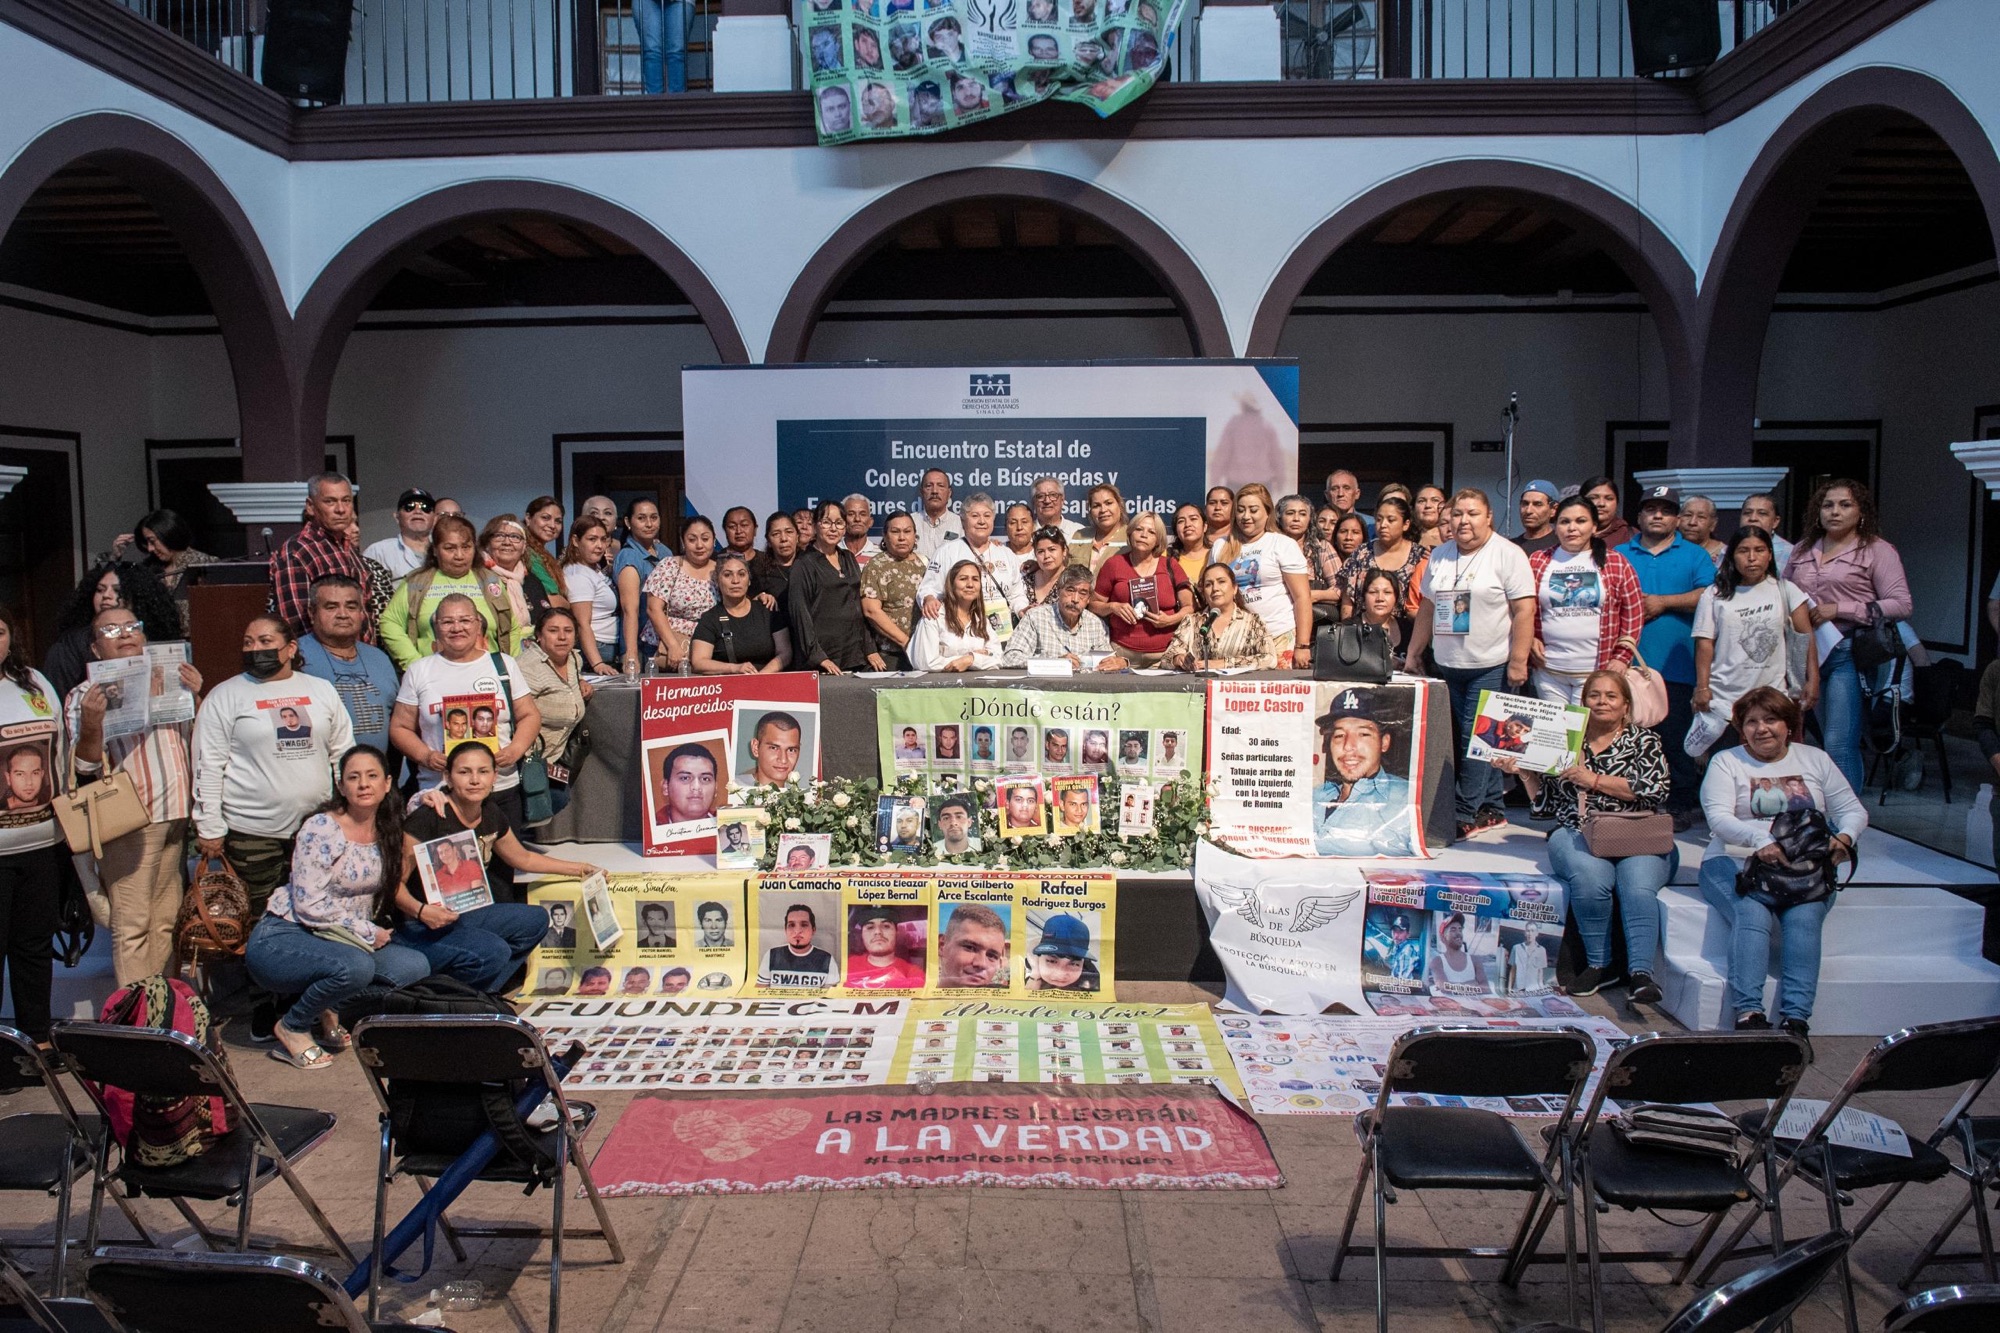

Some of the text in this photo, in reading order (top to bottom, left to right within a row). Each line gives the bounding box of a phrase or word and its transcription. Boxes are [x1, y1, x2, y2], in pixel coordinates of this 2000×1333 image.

[891, 439, 1092, 459] Encuentro Estatal de
[865, 468, 964, 487] Colectos
[968, 468, 992, 487] de
[1108, 471, 1119, 486] y
[1740, 608, 1756, 618] VEN
[1763, 603, 1774, 612] MI
[655, 683, 723, 702] Hermanos
[1219, 681, 1311, 696] Johan Edgardo
[1225, 698, 1304, 713] Lopez Castro
[1495, 694, 1527, 704] Colectivo
[1538, 701, 1562, 710] Padres
[643, 699, 735, 722] desaparecidos
[959, 696, 1121, 722] ¿Dónde están?
[1502, 702, 1527, 711] Madres
[1539, 707, 1557, 716] Hijos
[1503, 708, 1554, 722] Desaparecidos
[13, 728, 25, 736] soy
[1221, 726, 1241, 735] Edad:
[280, 739, 309, 747] SWAGGY
[1248, 737, 1279, 747] 30 años
[1221, 752, 1294, 763] Señas particulares:
[1230, 767, 1296, 777] Tatuaje arriba del
[1231, 778, 1294, 789] tobillo izquierdo,
[1235, 789, 1290, 800] con la leyenda
[1242, 799, 1283, 809] de Romina
[607, 882, 640, 893] uliacán,
[759, 879, 842, 890] Juan Camacho
[847, 879, 928, 888] Francisco Eleazar
[937, 880, 1014, 890] David Gilberto
[1040, 881, 1088, 895] Rafael
[857, 889, 918, 902] López Bernal
[937, 890, 1014, 902] Arce Escalante
[1373, 893, 1418, 905] López Castro
[1437, 891, 1491, 905] Camilo Carrillo
[1021, 896, 1106, 911] Rodriguez Burgos
[1449, 902, 1477, 912] Jaquez
[1517, 900, 1537, 911] Edgar
[1264, 905, 1290, 916] ALAS
[1509, 909, 1559, 922] López Vázquez
[1268, 921, 1283, 932] DE
[1249, 928, 1302, 948] BÚSQUEDA
[1246, 960, 1309, 977] LA BÚSQUEDA
[1324, 962, 1337, 972] EN
[771, 973, 826, 986] SWAGGY
[1379, 984, 1411, 994] Contreras
[1466, 985, 1482, 993] Vega
[532, 1000, 900, 1018] FUUNDEC-M
[942, 1002, 1168, 1021] ¿Dónde están?
[825, 1102, 1199, 1124] LAS MADRES LLEGARÁN
[815, 1124, 1215, 1154] A LA VERDAD
[864, 1153, 1174, 1167] #LasMadresNoSeRinden
